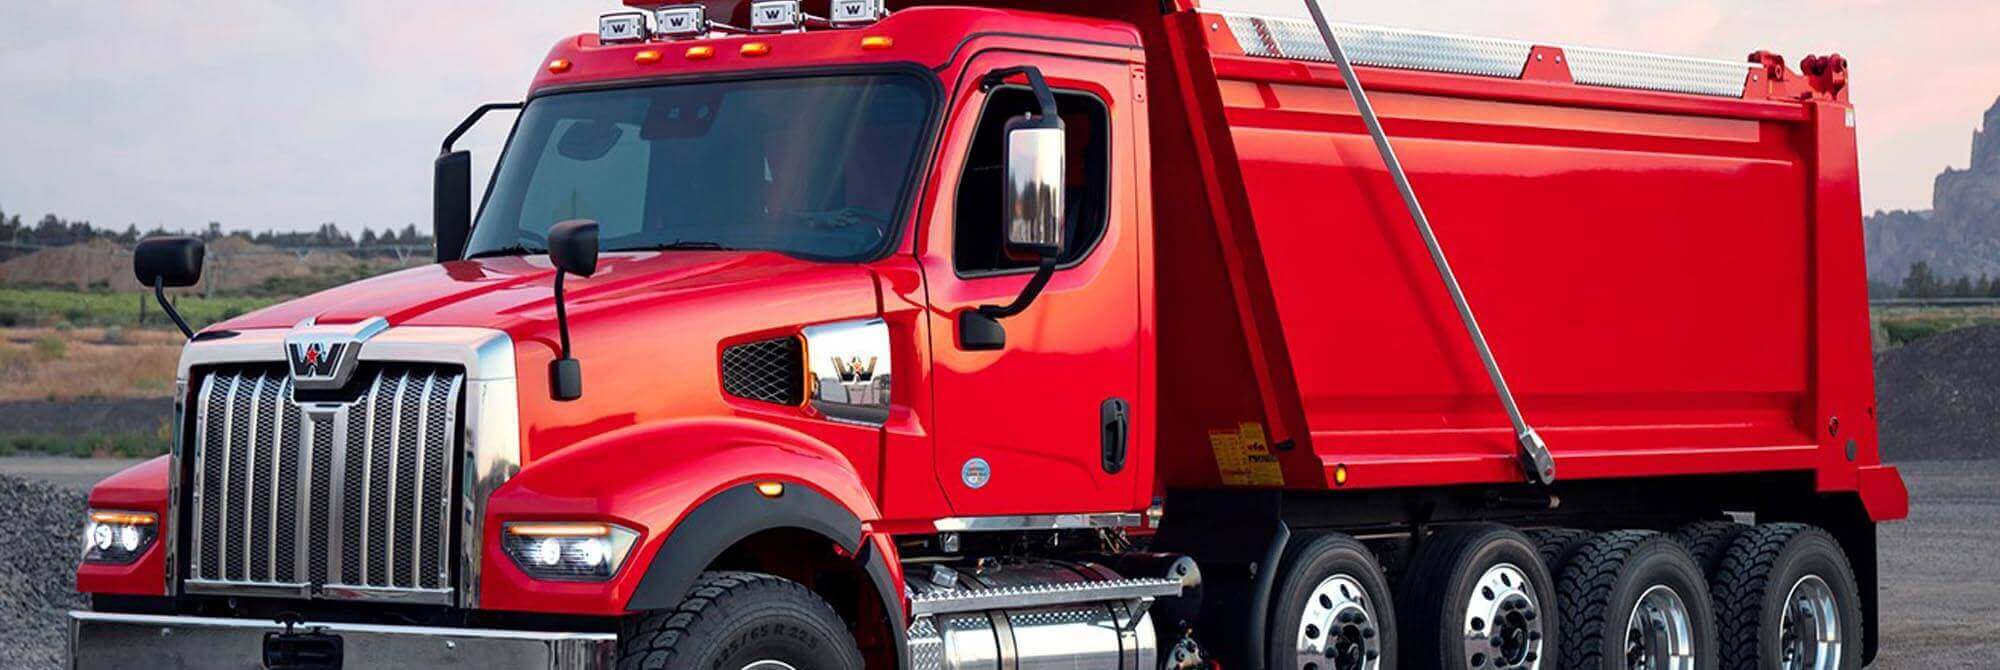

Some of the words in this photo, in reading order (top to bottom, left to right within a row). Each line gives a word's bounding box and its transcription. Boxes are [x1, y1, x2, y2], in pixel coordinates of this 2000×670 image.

[766, 10, 780, 19] W
[846, 5, 860, 15] W
[670, 17, 684, 27] W
[612, 24, 626, 33] W
[774, 623, 785, 636] R
